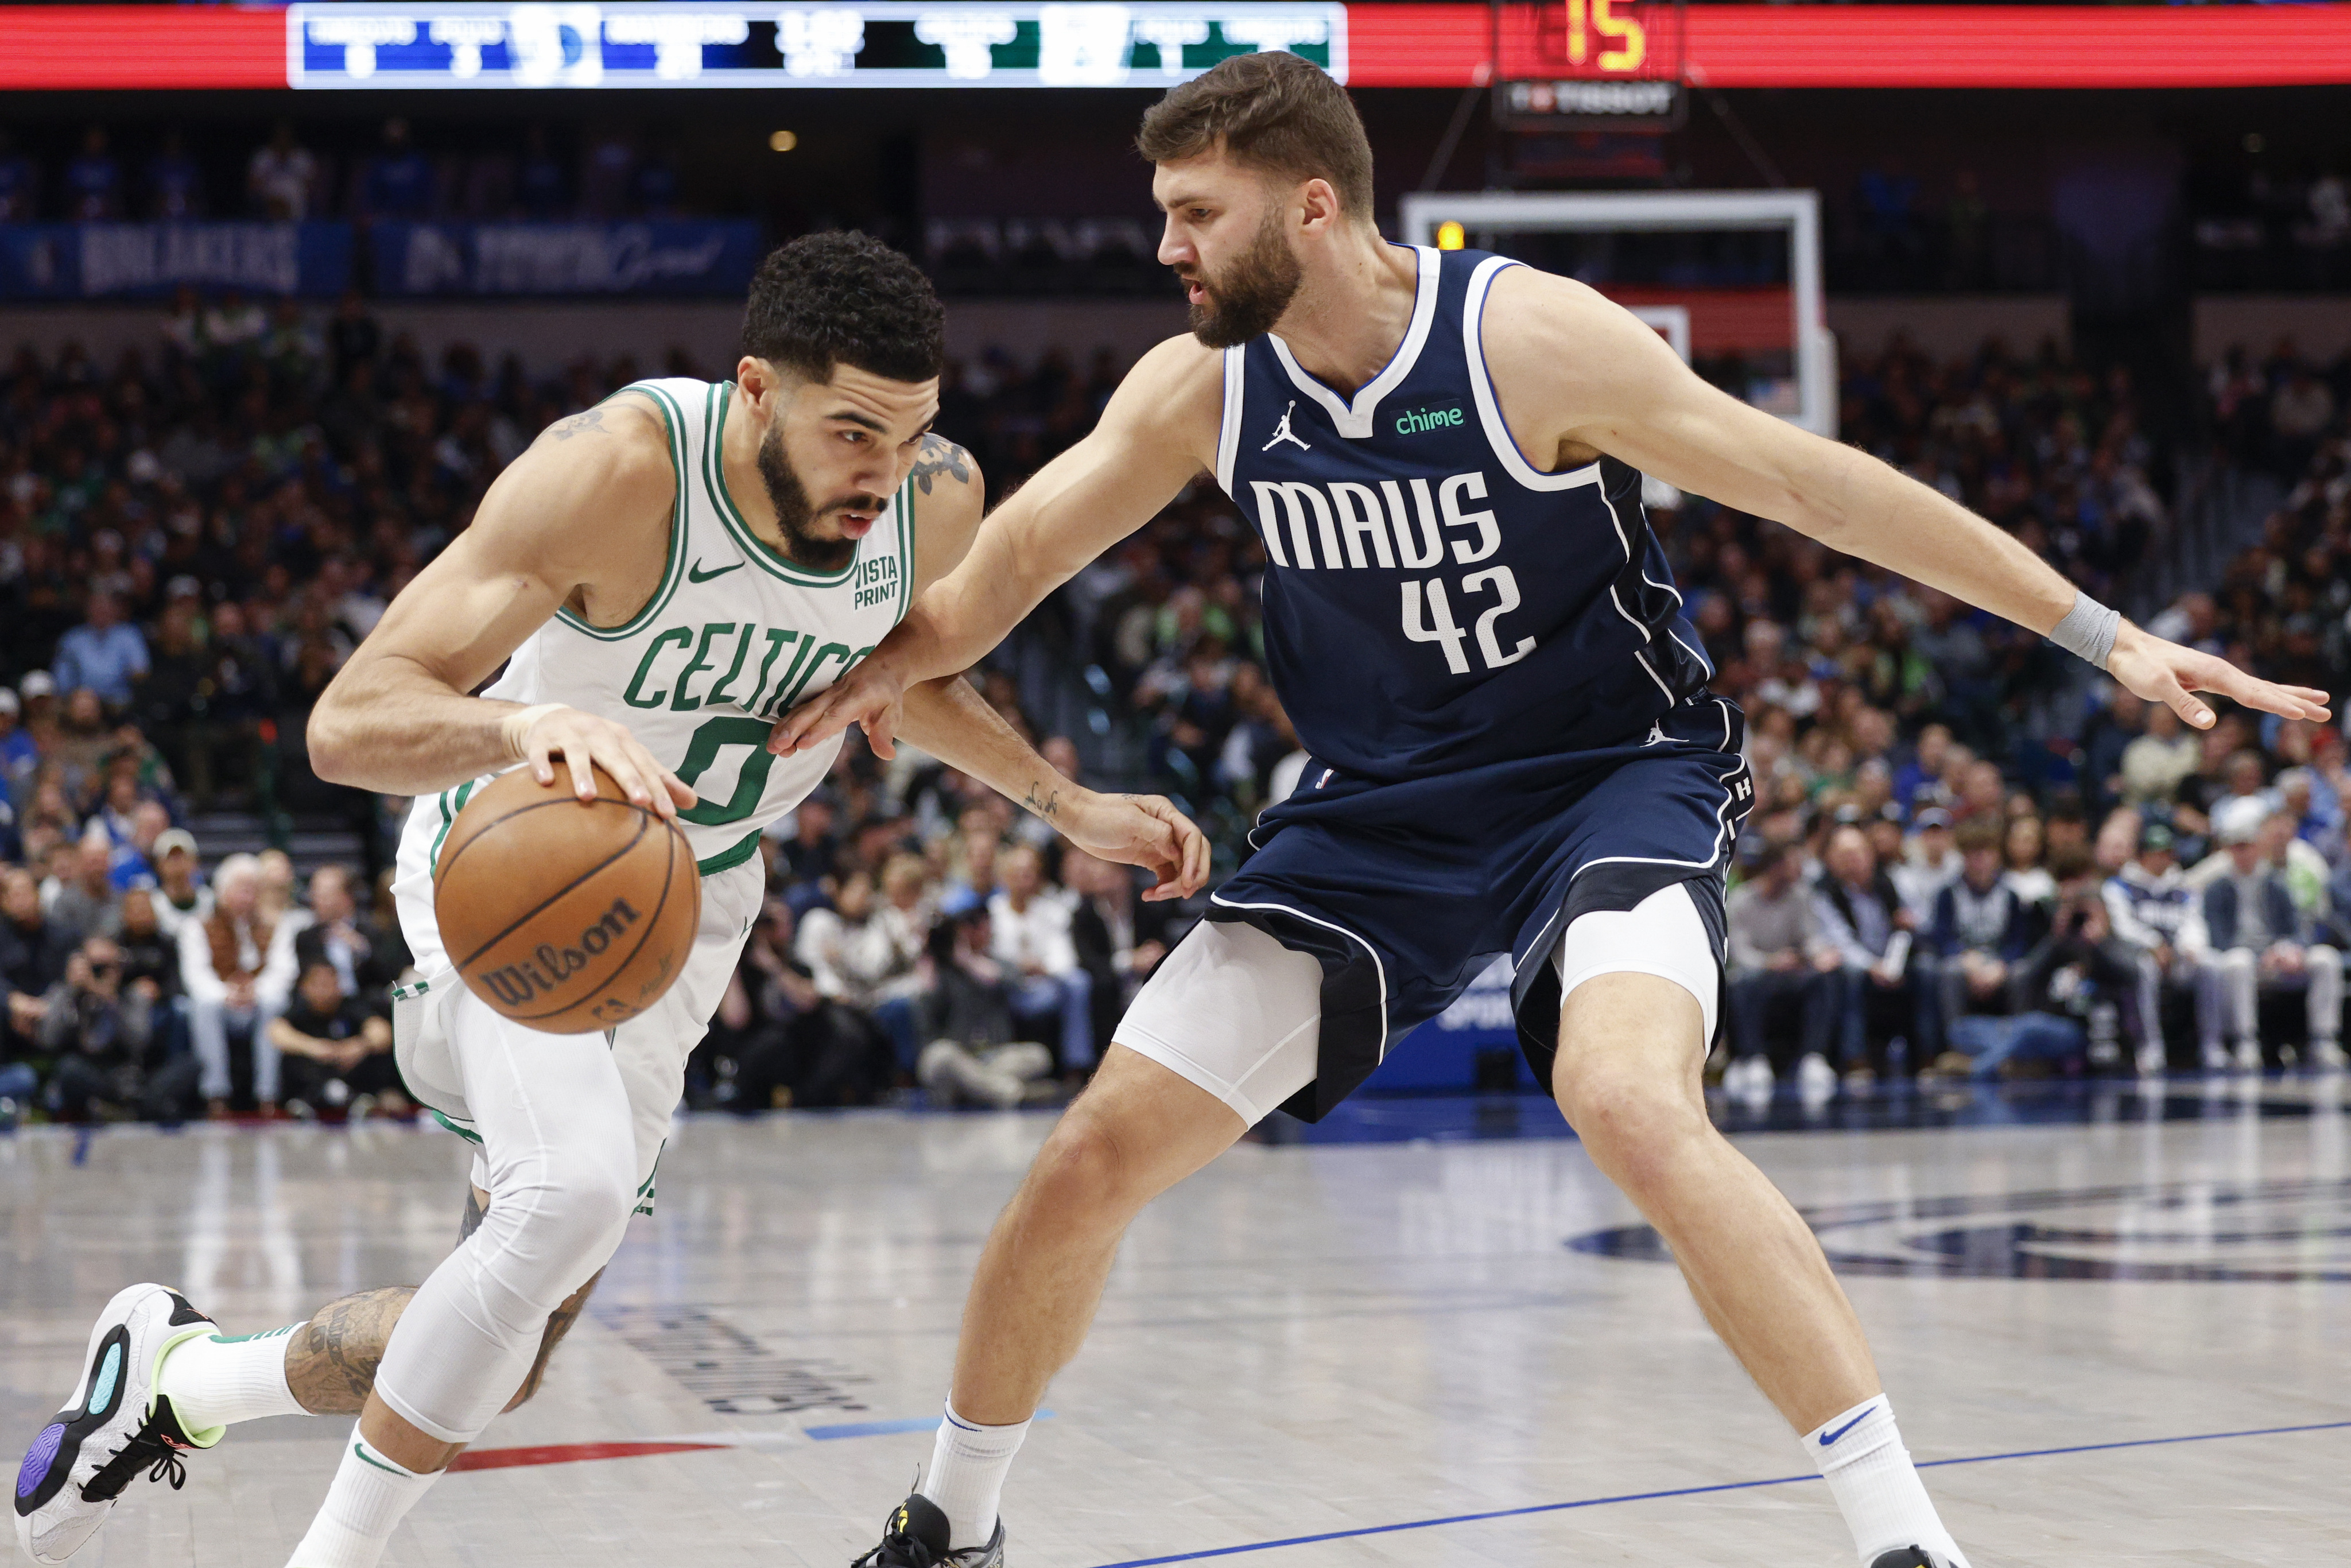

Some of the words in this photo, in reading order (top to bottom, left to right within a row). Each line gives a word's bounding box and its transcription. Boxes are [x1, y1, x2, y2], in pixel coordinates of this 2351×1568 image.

[1566, 0, 1646, 72] 15
[1396, 407, 1464, 435] chime
[1249, 472, 1502, 570] MAVS
[855, 580, 898, 610] PRINT
[1402, 565, 1537, 674] 42
[676, 717, 777, 825] 0
[479, 896, 641, 1007] Wilson
